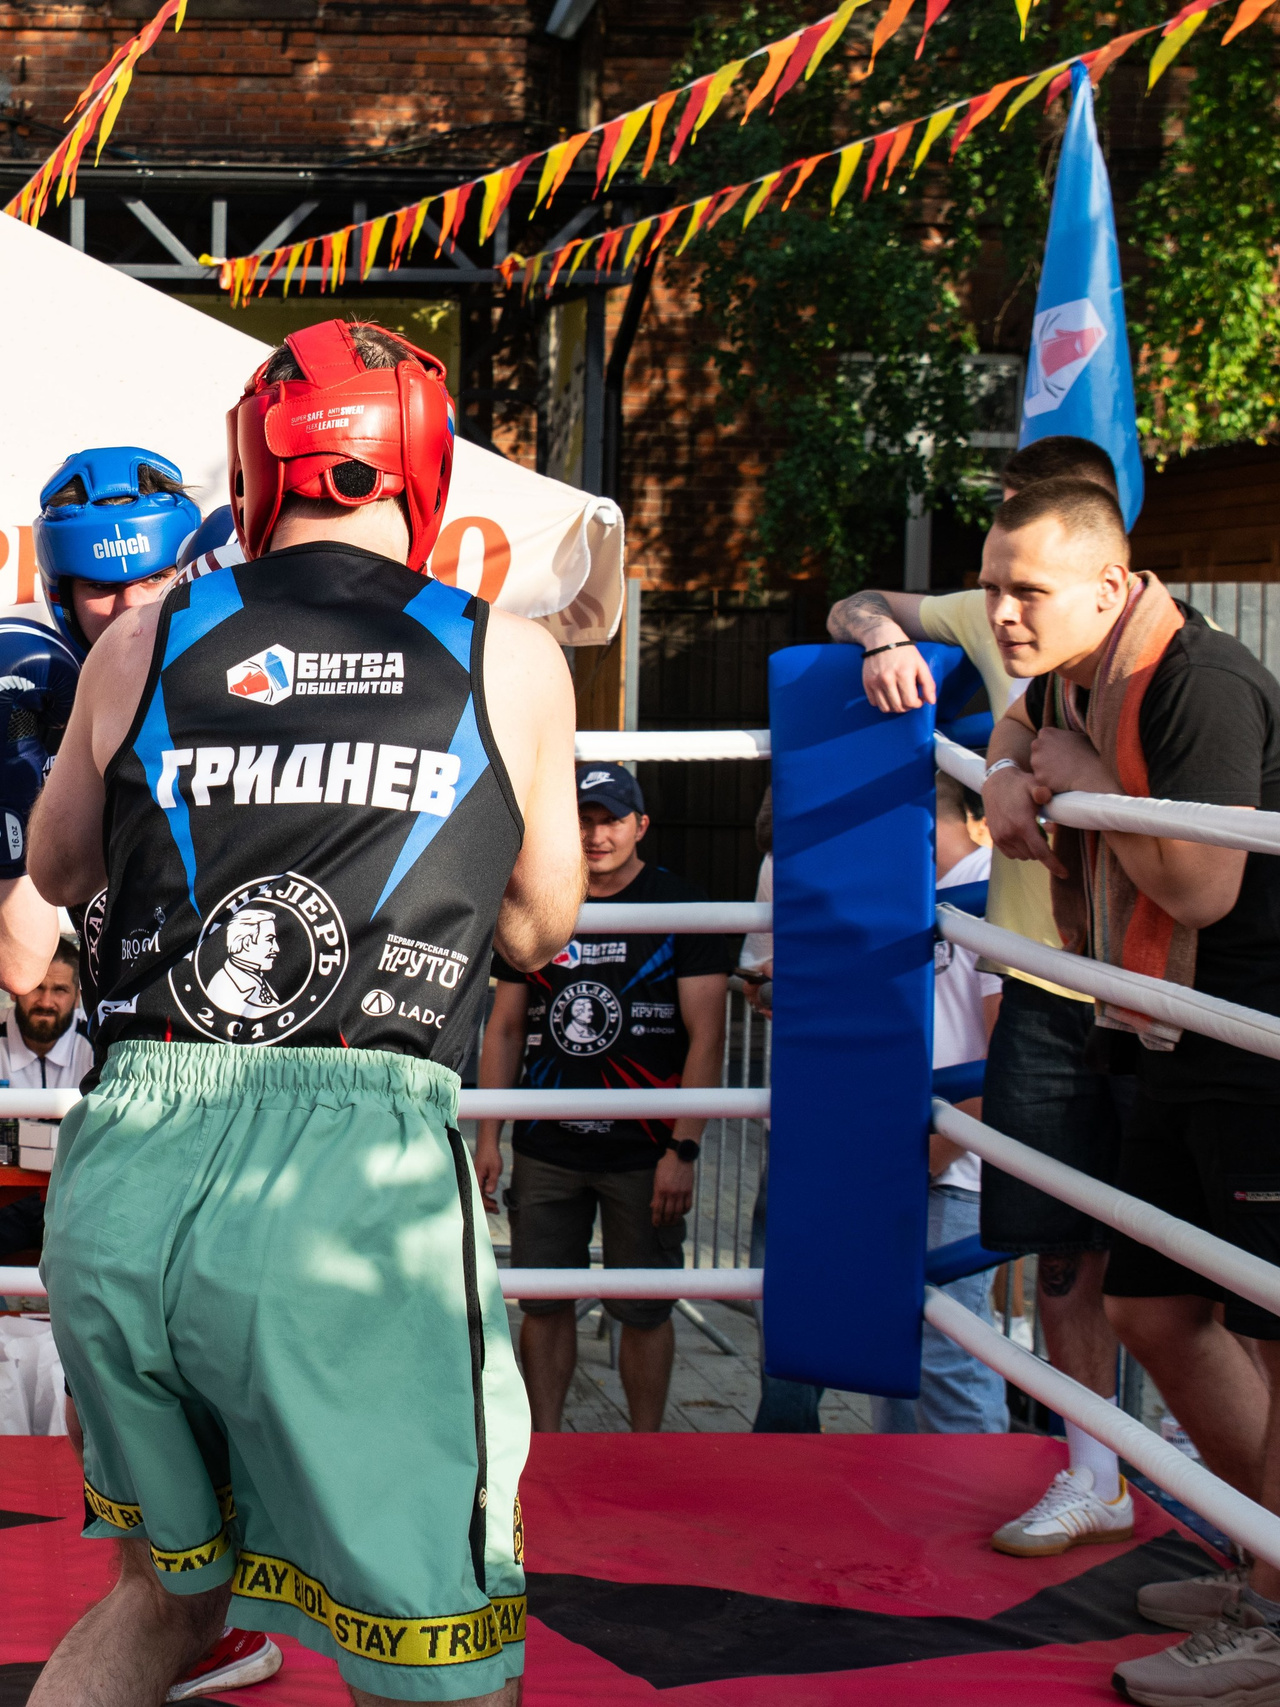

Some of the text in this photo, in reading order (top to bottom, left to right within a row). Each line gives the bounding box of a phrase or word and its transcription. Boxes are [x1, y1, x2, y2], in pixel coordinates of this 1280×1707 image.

[307, 410, 324, 421] SAFE
[340, 405, 365, 415] SWEAT
[318, 418, 349, 430] LEATHER
[93, 532, 151, 559] clinch
[297, 652, 405, 679] БИТВА
[295, 681, 404, 695] ОБЩЕПИТОВ
[157, 742, 461, 818] ГРИДНЕВ
[386, 933, 416, 948] ПЕРВАЯ
[414, 940, 451, 957] РУССКАЯ
[582, 942, 627, 957] БИТВА
[377, 943, 465, 989] КРУТО
[553, 983, 619, 1024] КАНЦЛЕРЪ
[562, 1037, 607, 1052] 2010
[334, 1613, 408, 1658] STAY
[420, 1613, 499, 1659] TRUE
